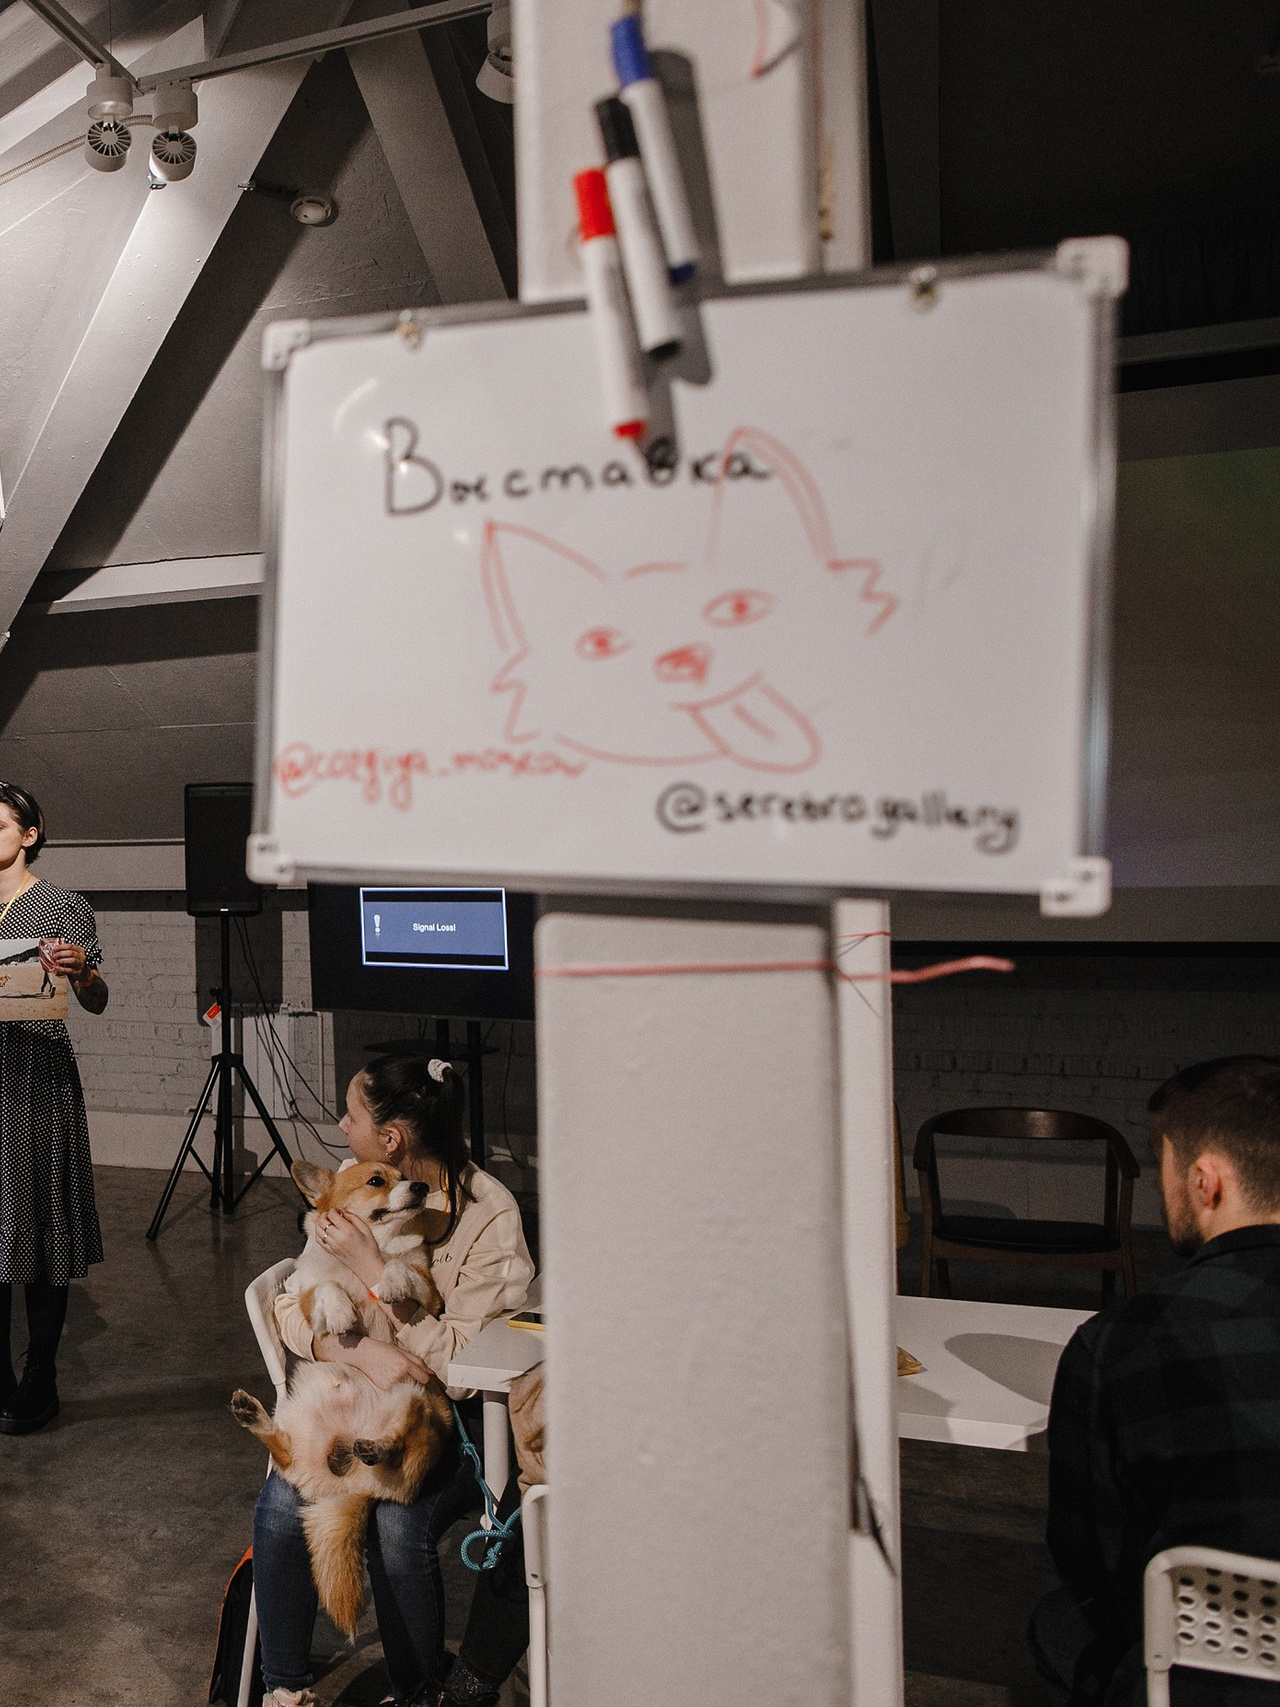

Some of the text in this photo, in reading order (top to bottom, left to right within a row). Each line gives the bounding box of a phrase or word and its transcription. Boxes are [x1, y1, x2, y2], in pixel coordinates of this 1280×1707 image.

[384, 417, 771, 516] Выставка
[412, 922, 456, 933] Signal Loss!
